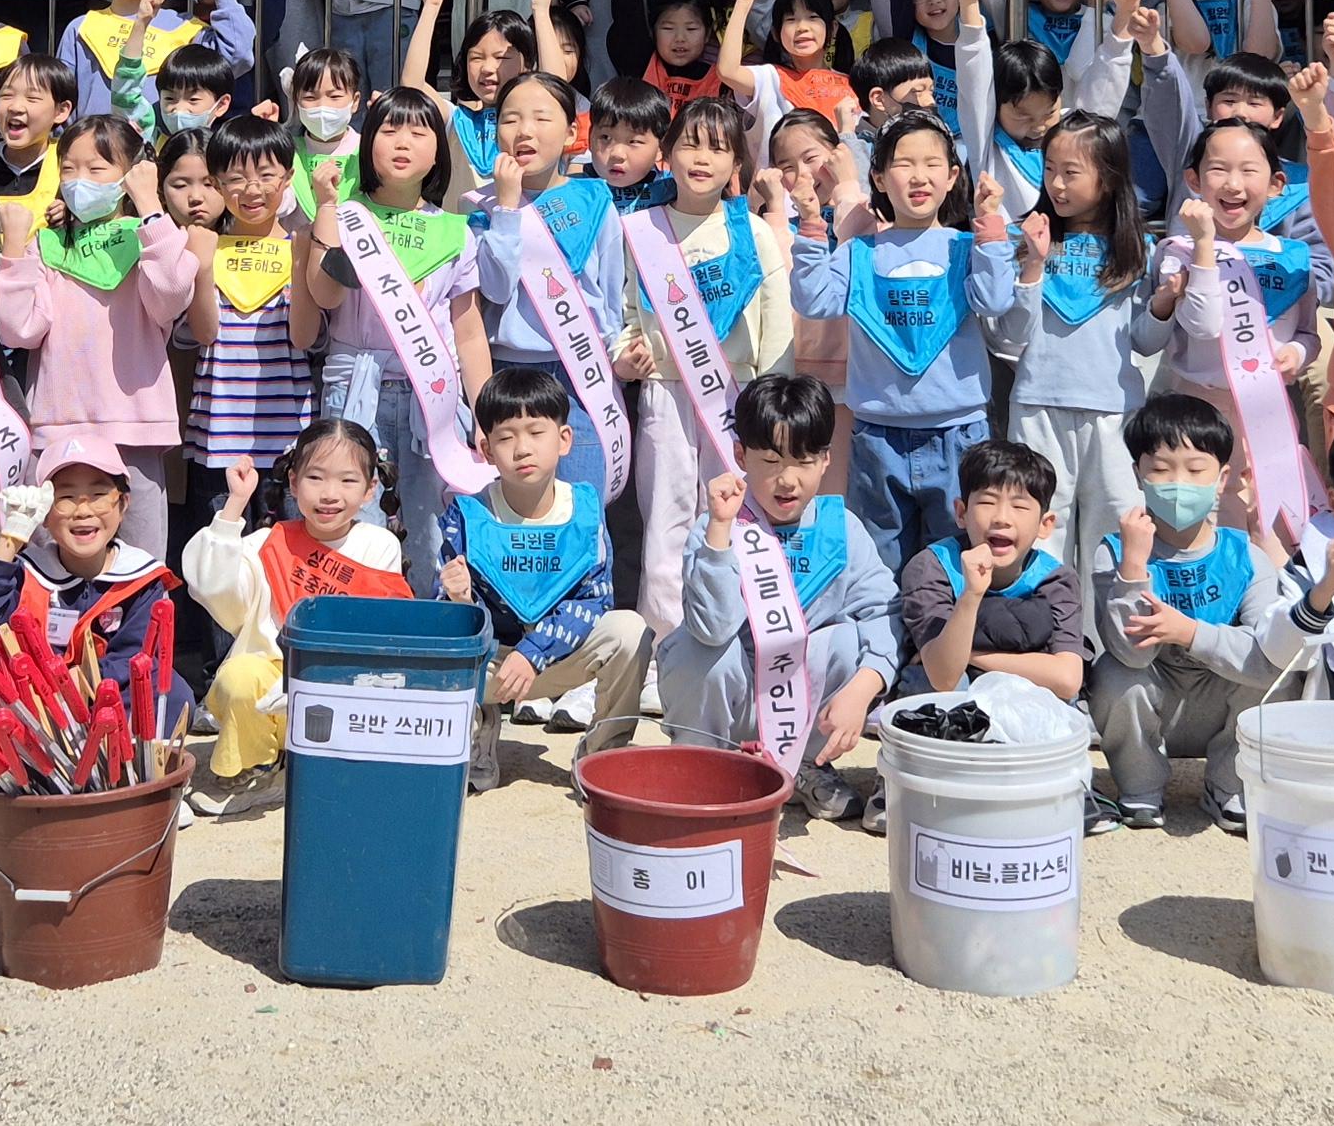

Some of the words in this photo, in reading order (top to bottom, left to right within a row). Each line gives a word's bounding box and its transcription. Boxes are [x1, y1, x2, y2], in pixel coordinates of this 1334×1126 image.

[385, 211, 427, 233] 최선을
[235, 238, 280, 256] 팀원과
[226, 257, 283, 275] 협동해요
[887, 289, 930, 306] 팀원을
[377, 274, 438, 367] 주인공
[883, 309, 936, 327] 배려해요
[552, 301, 606, 390] 오늘의
[672, 305, 725, 396] 오늘의
[61, 440, 85, 459] A
[510, 532, 556, 550] 팀원을
[309, 548, 356, 584] 상대를
[502, 556, 562, 573] 배려해요
[742, 528, 793, 635] 오늘의
[347, 712, 388, 737] 일반
[393, 715, 453, 739] 쓰레기
[632, 866, 650, 890] 종
[686, 869, 706, 891] 이
